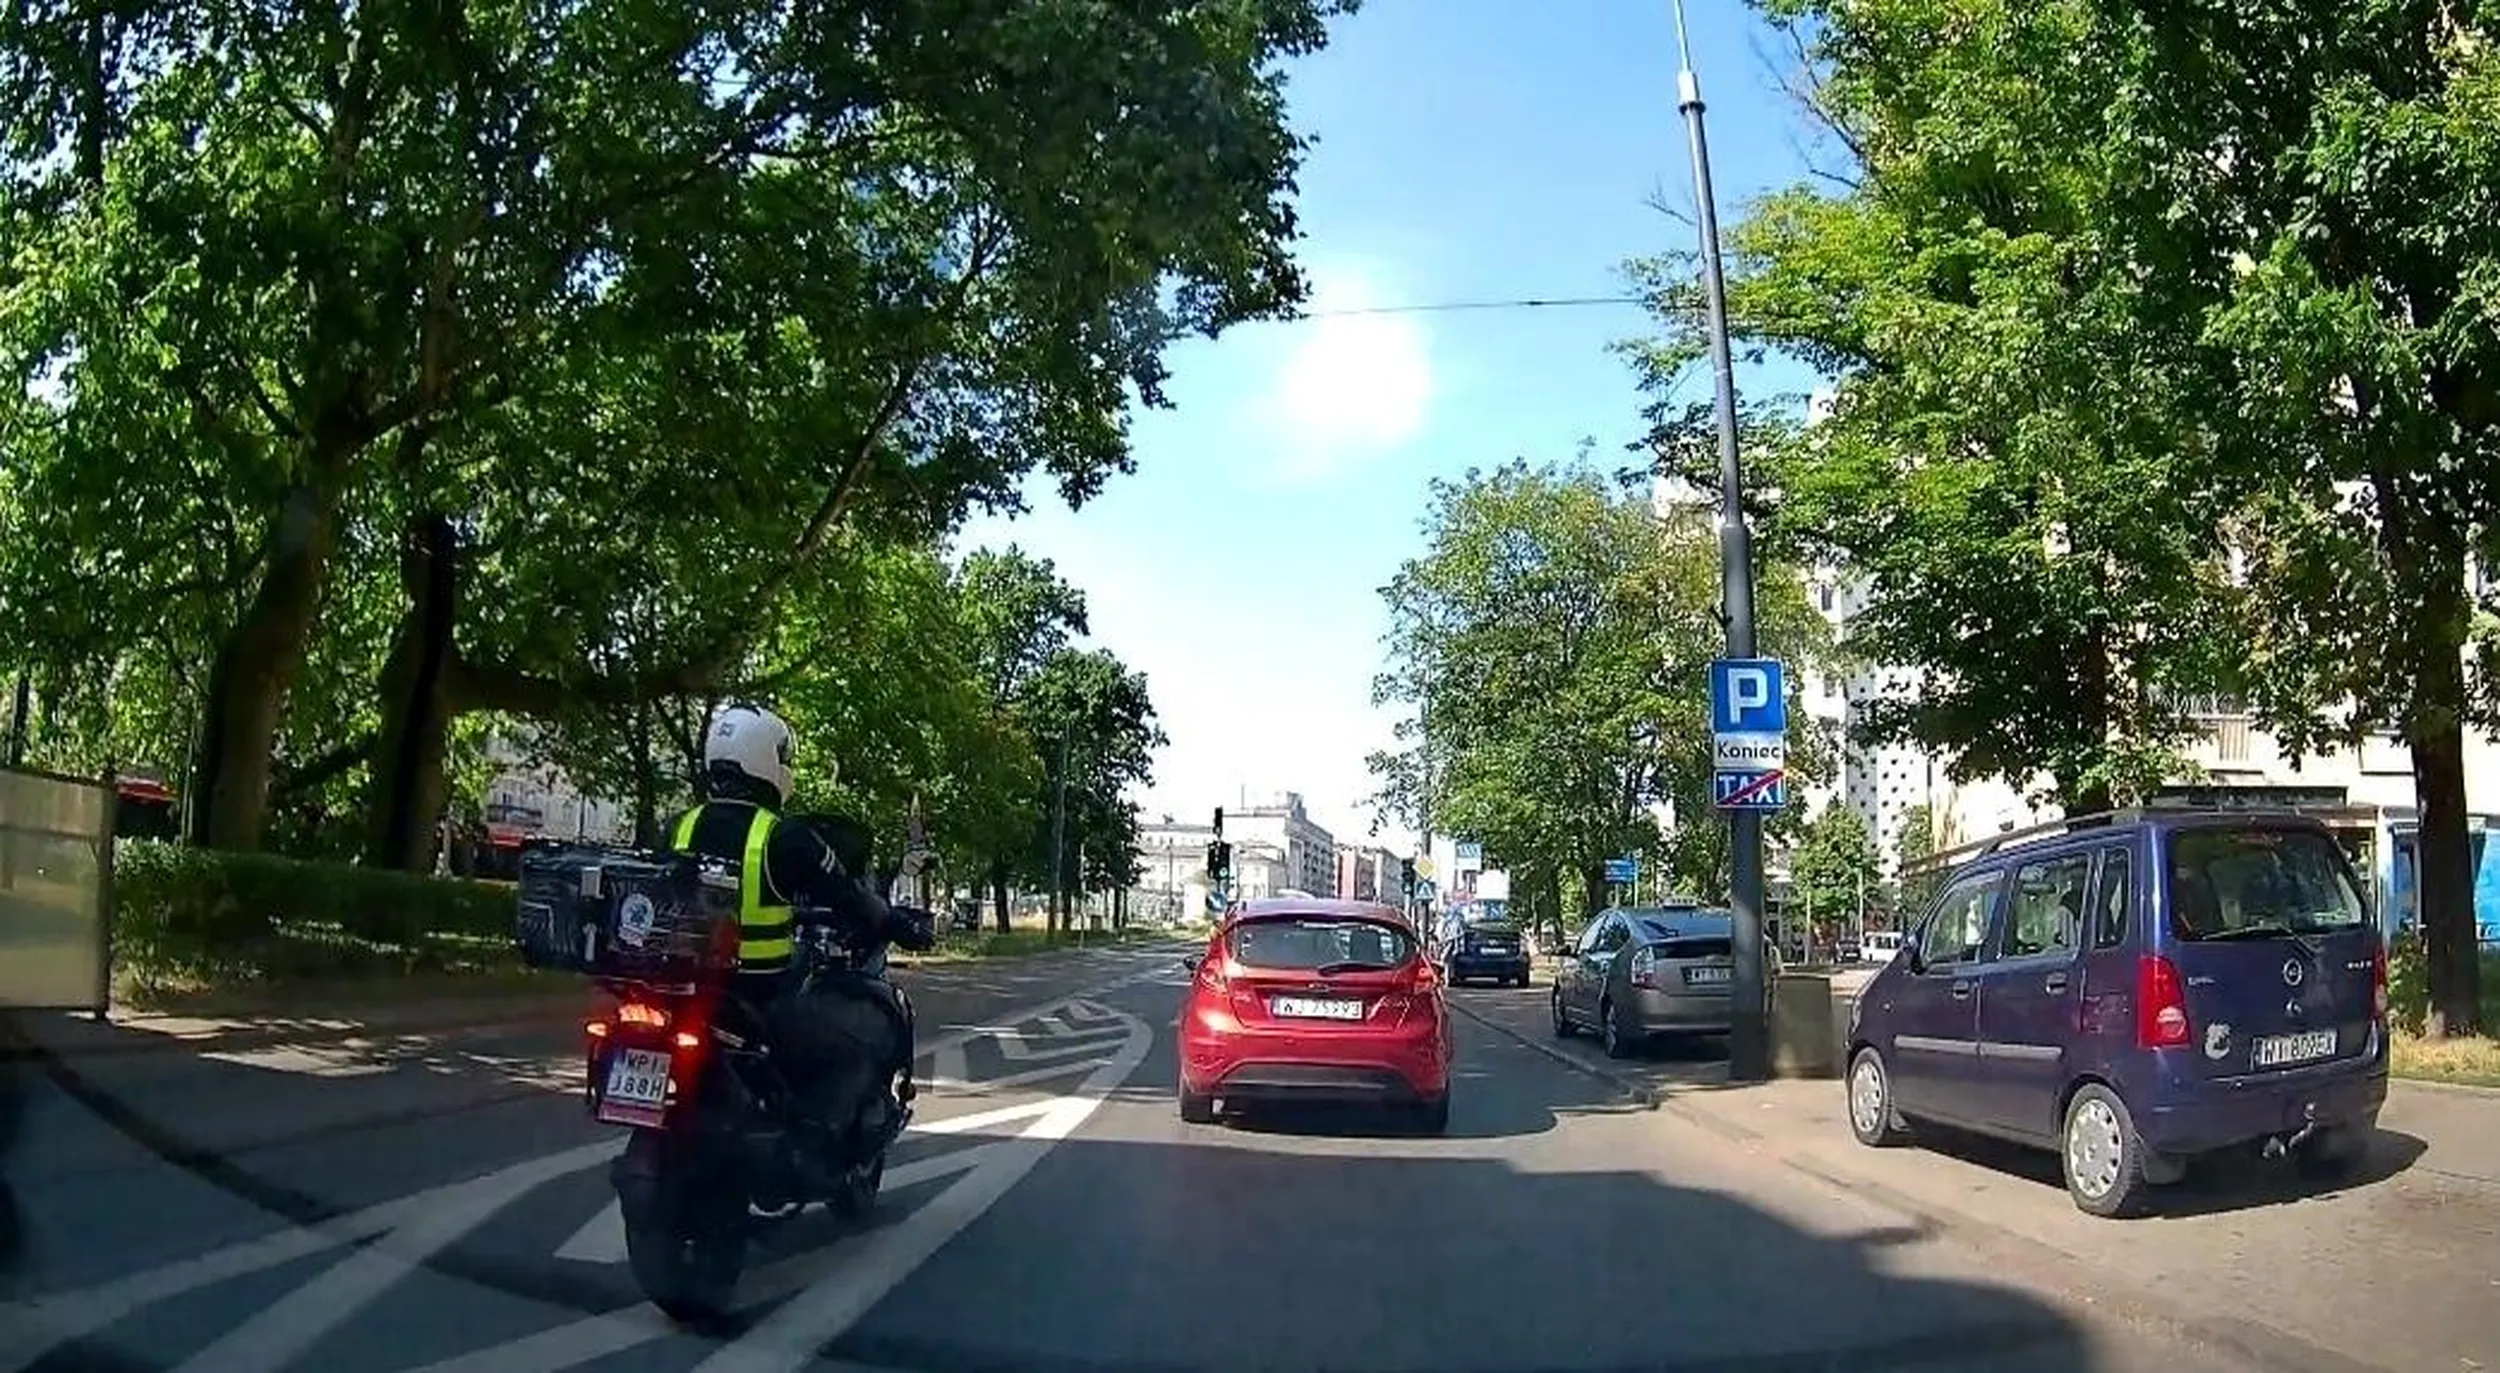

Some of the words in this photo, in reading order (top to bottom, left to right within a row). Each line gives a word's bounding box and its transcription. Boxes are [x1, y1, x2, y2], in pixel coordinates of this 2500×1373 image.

[1727, 668, 1769, 724] P
[1718, 740, 1781, 759] Koniec
[1718, 774, 1783, 804] TAXI
